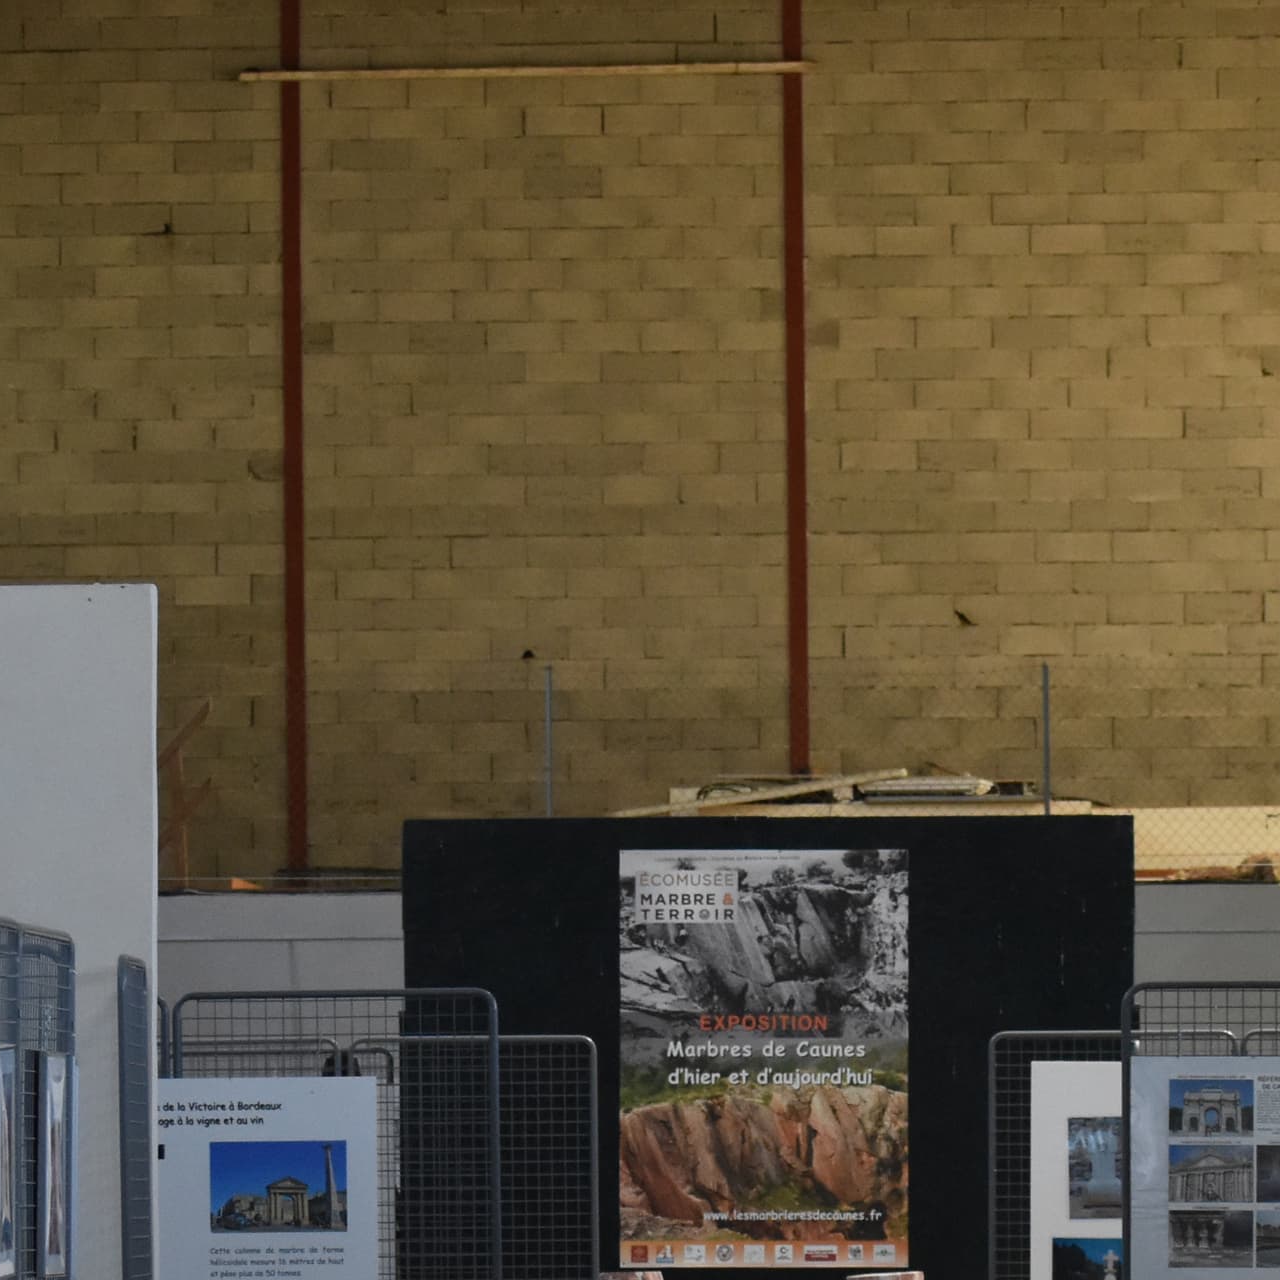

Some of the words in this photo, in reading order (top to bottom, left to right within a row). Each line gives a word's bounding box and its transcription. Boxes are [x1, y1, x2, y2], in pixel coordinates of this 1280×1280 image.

[639, 872, 735, 887] ÉCOMUSÉE
[640, 893, 716, 905] MARBRE
[641, 909, 735, 920] TERROIR
[699, 1015, 828, 1031] EXPOSITION
[667, 1041, 752, 1057] Marbres
[762, 1041, 786, 1057] de
[796, 1041, 865, 1057] Caunes
[668, 1068, 721, 1085] d'hier
[729, 1068, 749, 1085] et
[757, 1068, 873, 1090] d'aujourd'hui
[163, 1102, 174, 1112] de
[177, 1102, 185, 1111] la
[188, 1102, 226, 1112] Victoire
[229, 1101, 235, 1111] à
[238, 1102, 282, 1111] Bordeaux
[186, 1116, 194, 1125] la
[197, 1116, 220, 1128] vigne
[223, 1116, 233, 1125] et
[236, 1117, 248, 1125] au
[250, 1116, 264, 1125] vin
